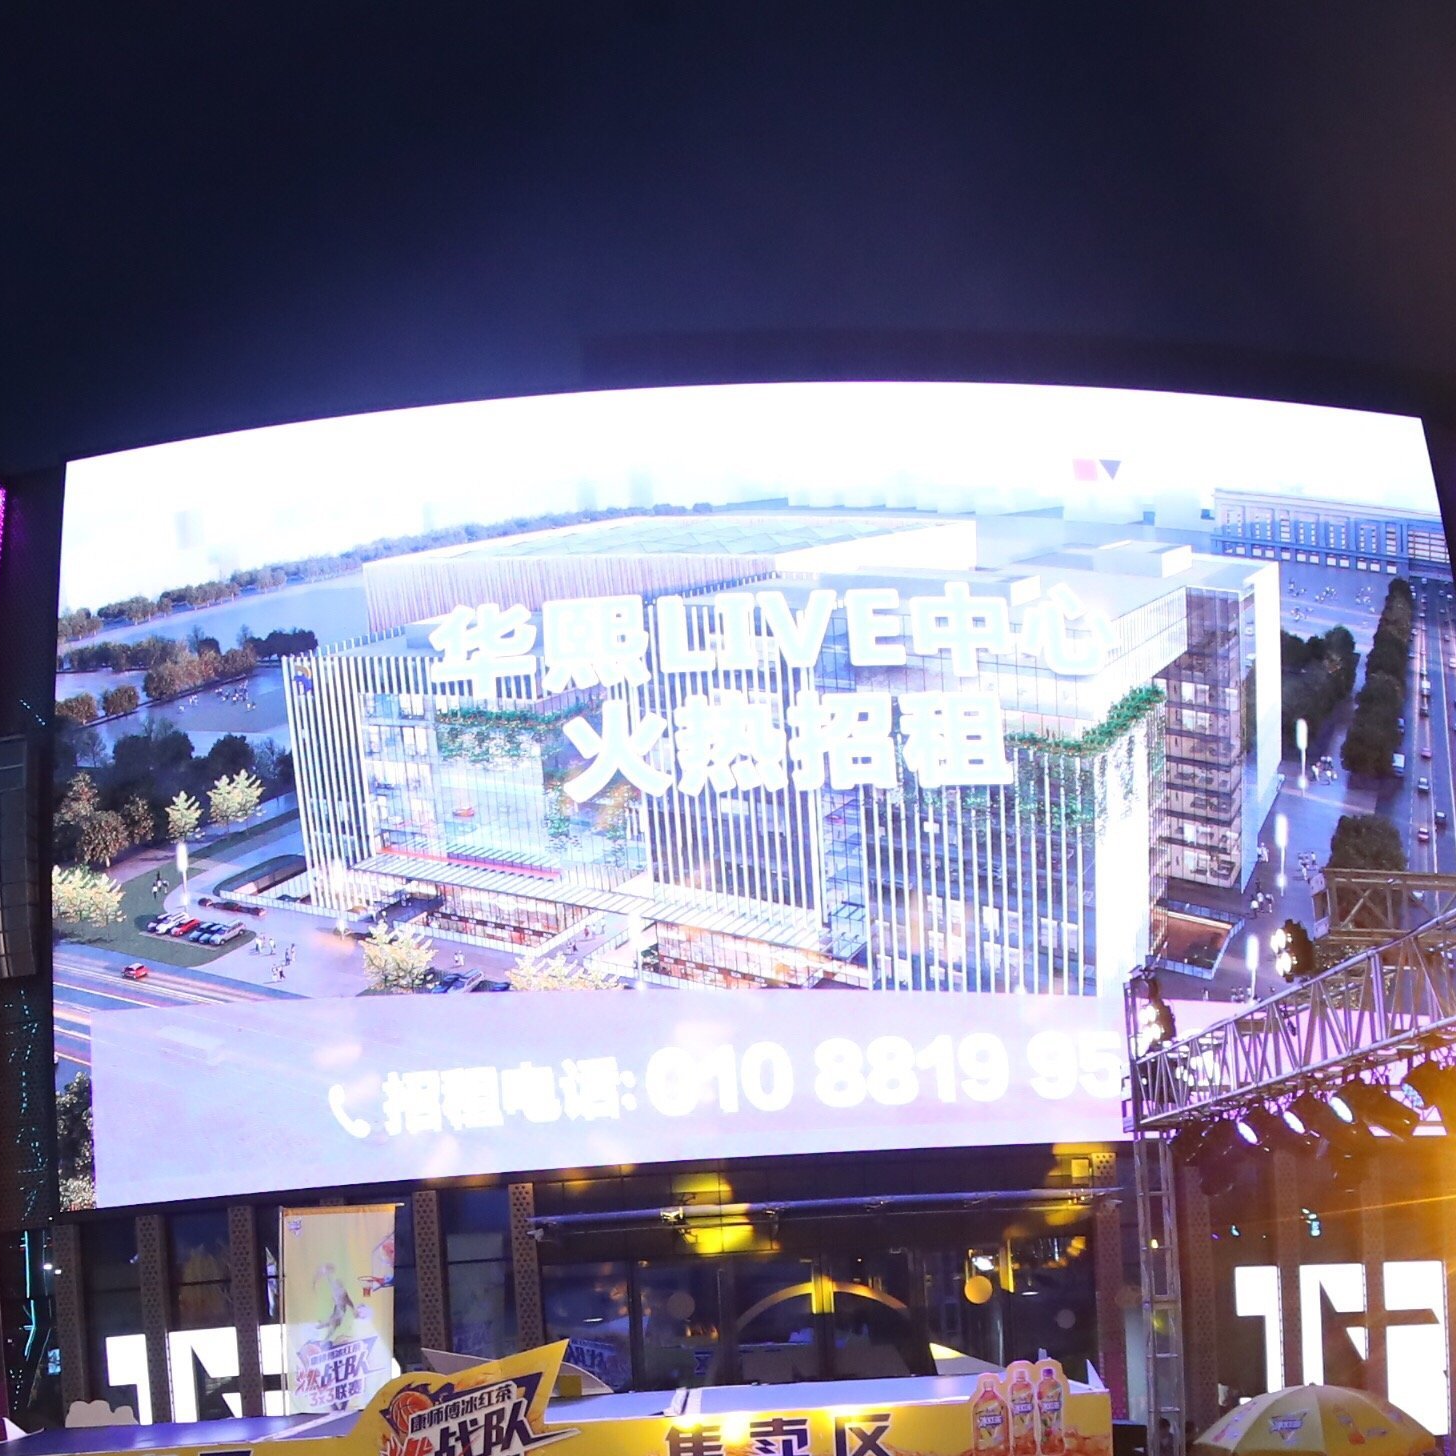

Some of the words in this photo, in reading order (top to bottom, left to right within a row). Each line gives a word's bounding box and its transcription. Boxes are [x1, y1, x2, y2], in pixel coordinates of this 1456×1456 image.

[429, 581, 1119, 702] 华熙LIVE中心
[563, 691, 1014, 802] 火热招租
[814, 1033, 1009, 1108] 8819
[411, 1383, 512, 1433] 康师傅冰红茶
